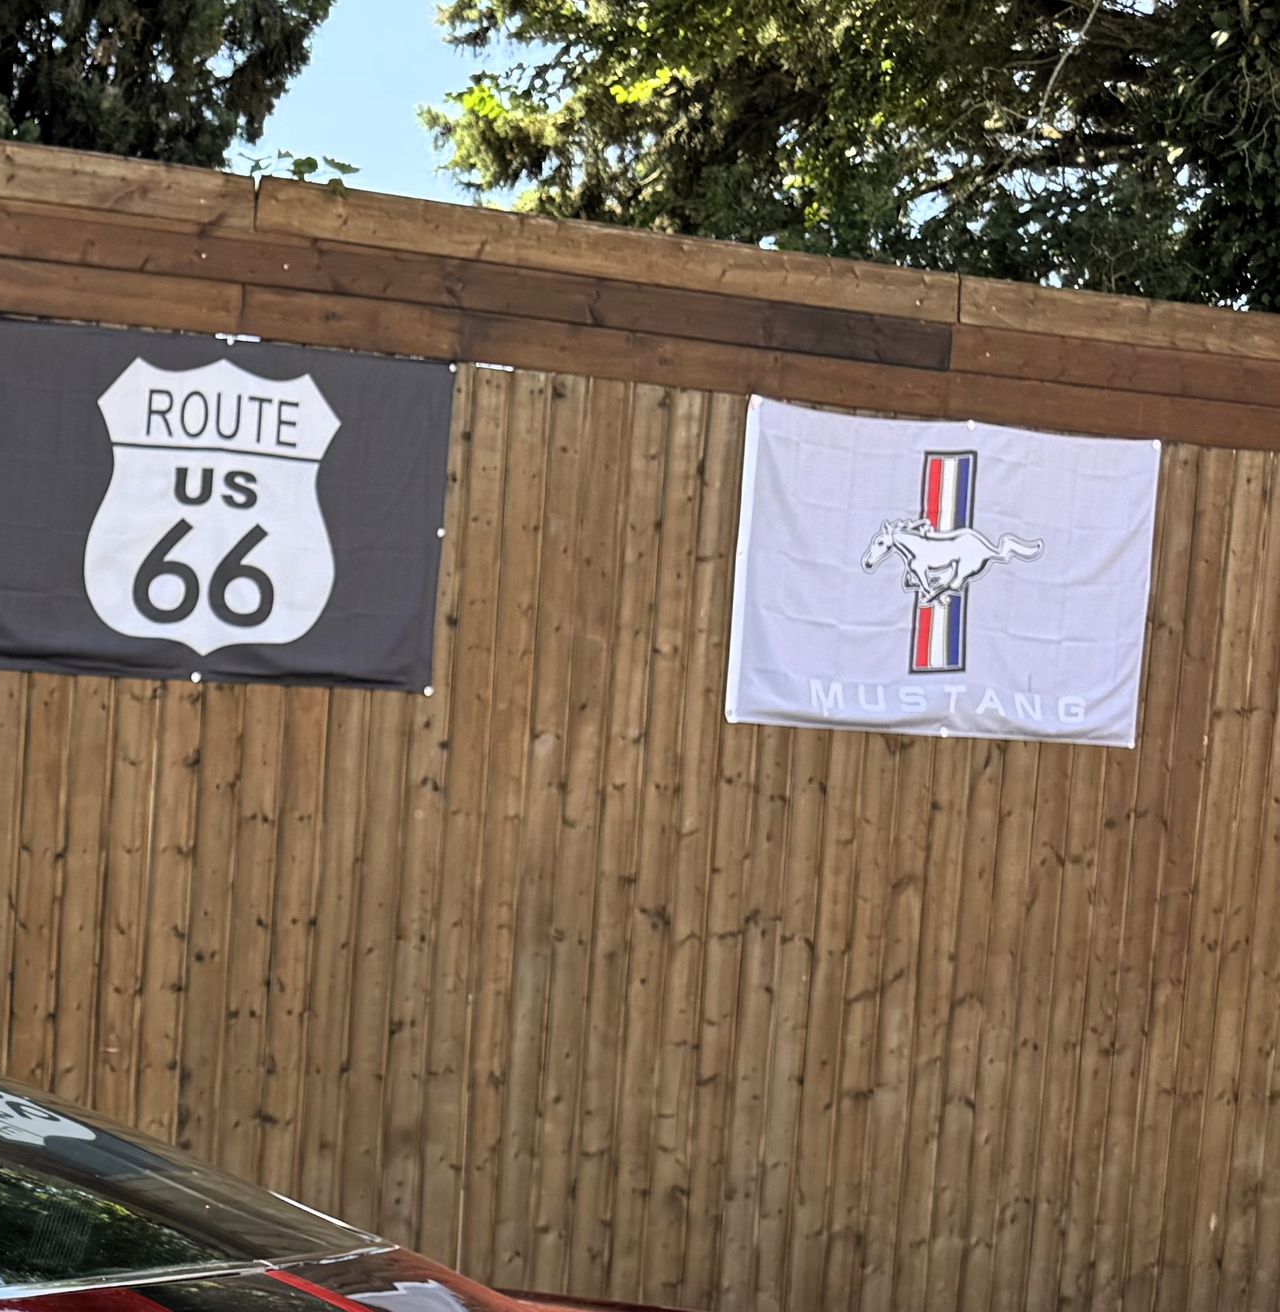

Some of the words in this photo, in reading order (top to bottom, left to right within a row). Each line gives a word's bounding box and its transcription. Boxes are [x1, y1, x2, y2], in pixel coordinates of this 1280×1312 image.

[145, 388, 300, 448] ROUTE
[173, 466, 259, 510] US
[132, 518, 275, 628] 66
[809, 678, 1088, 724] MUSTANG
